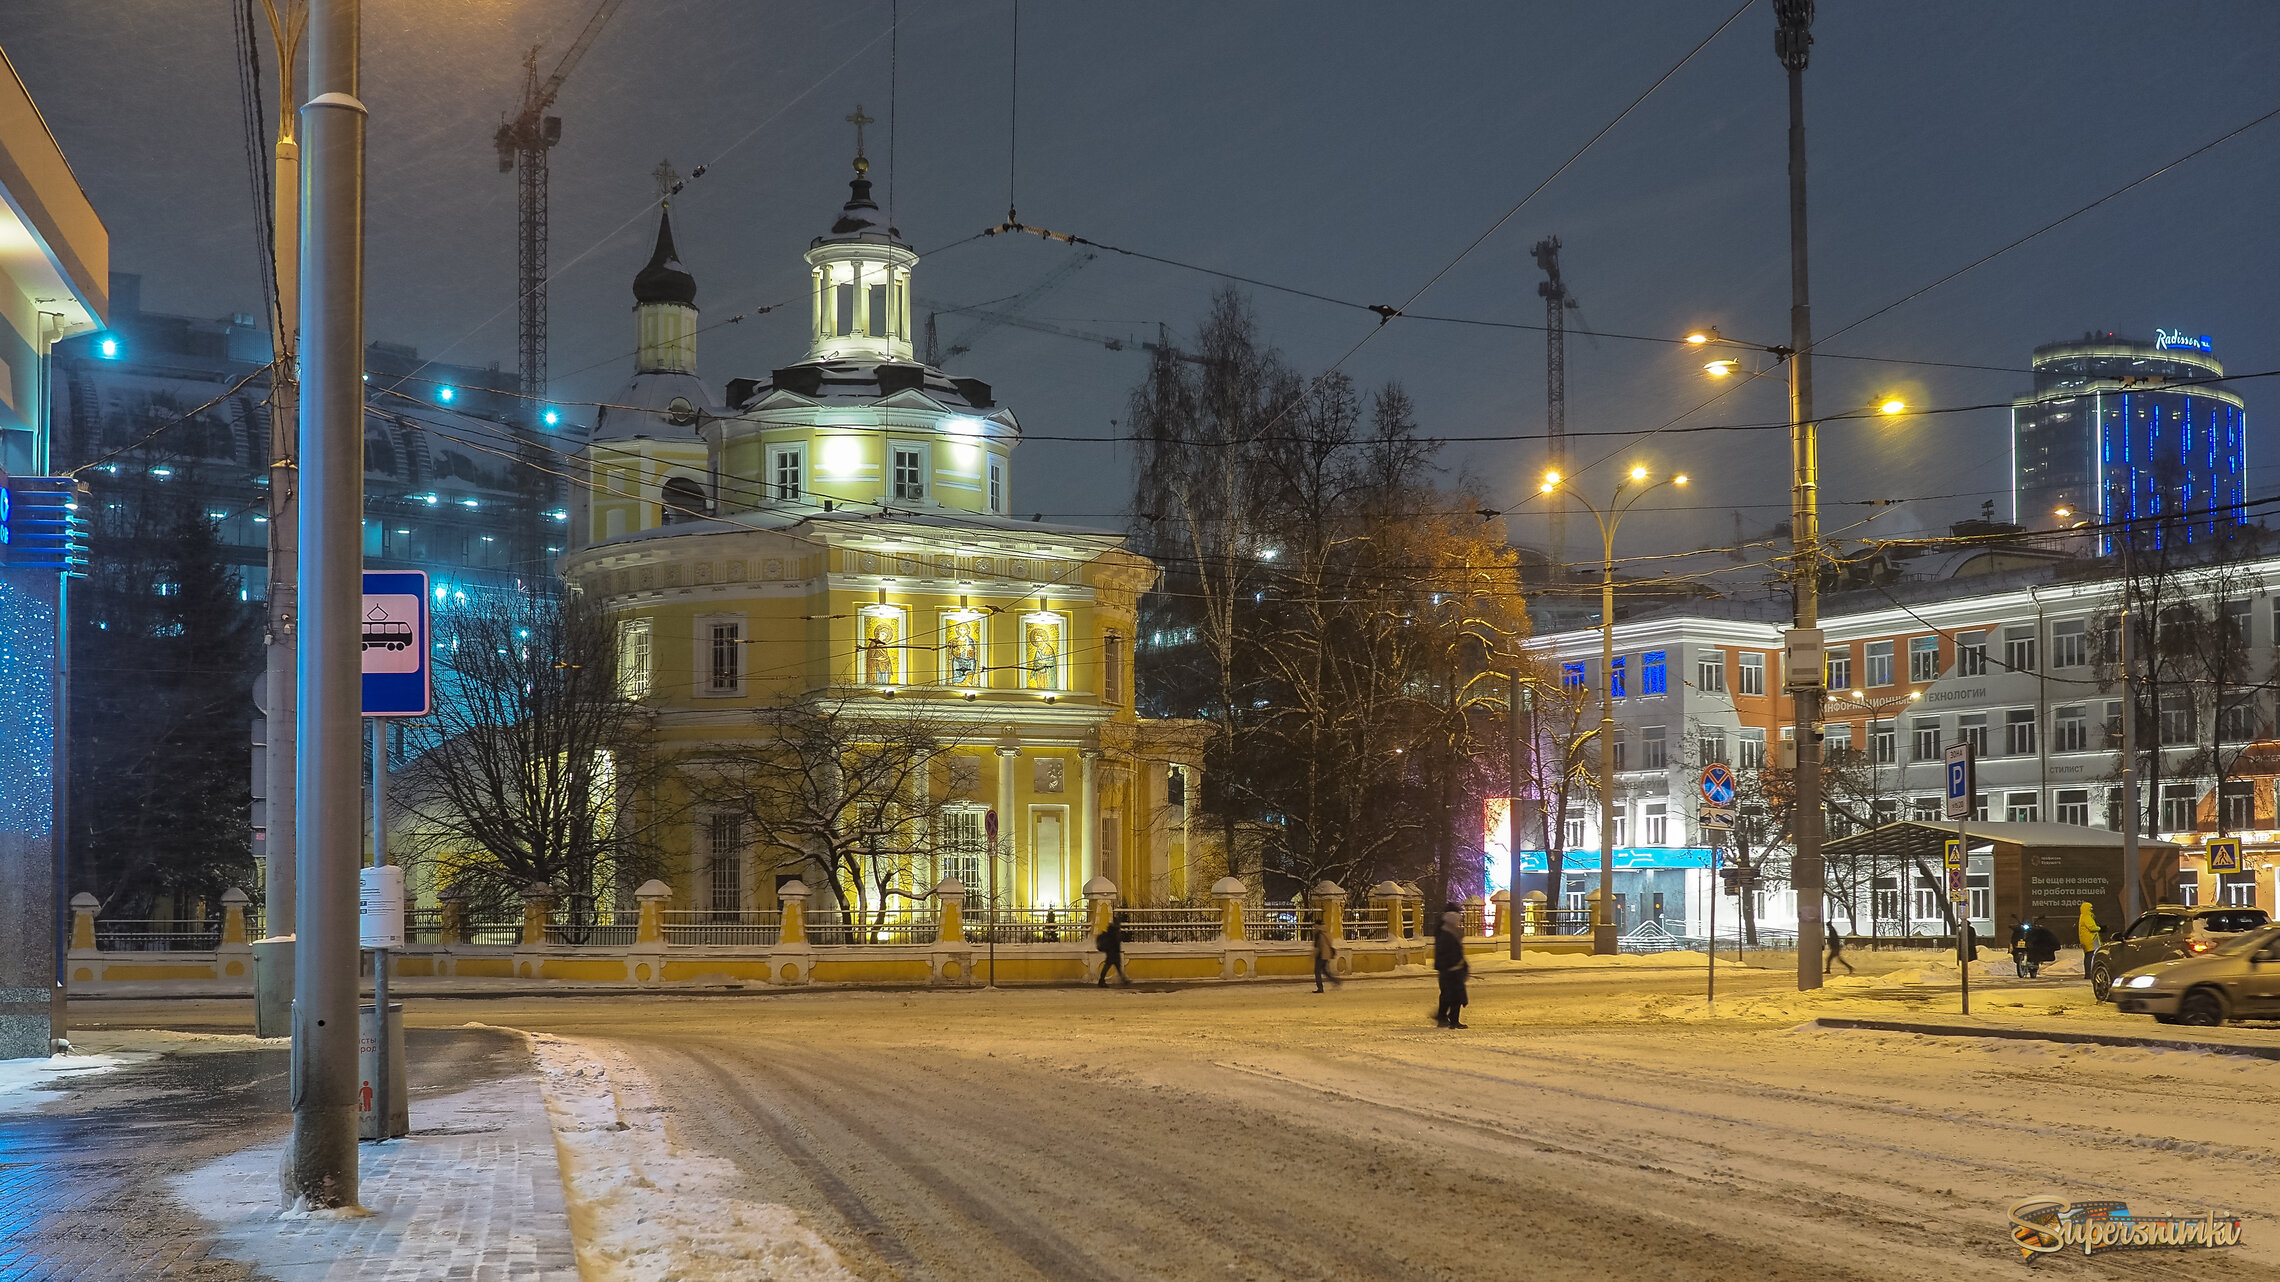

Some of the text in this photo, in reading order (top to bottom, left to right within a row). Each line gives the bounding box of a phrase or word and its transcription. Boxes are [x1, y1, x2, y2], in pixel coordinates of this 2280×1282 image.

[2155, 328, 2200, 350] Radisson
[2049, 765, 2084, 774] СТИЛИСТ
[1953, 765, 1963, 795] P
[2031, 876, 2045, 884] Вы
[2046, 877, 2065, 885] еще
[2077, 877, 2109, 885] знаете,
[2043, 887, 2075, 897] работа
[2076, 887, 2106, 895] вашей
[2061, 899, 2084, 907] здес
